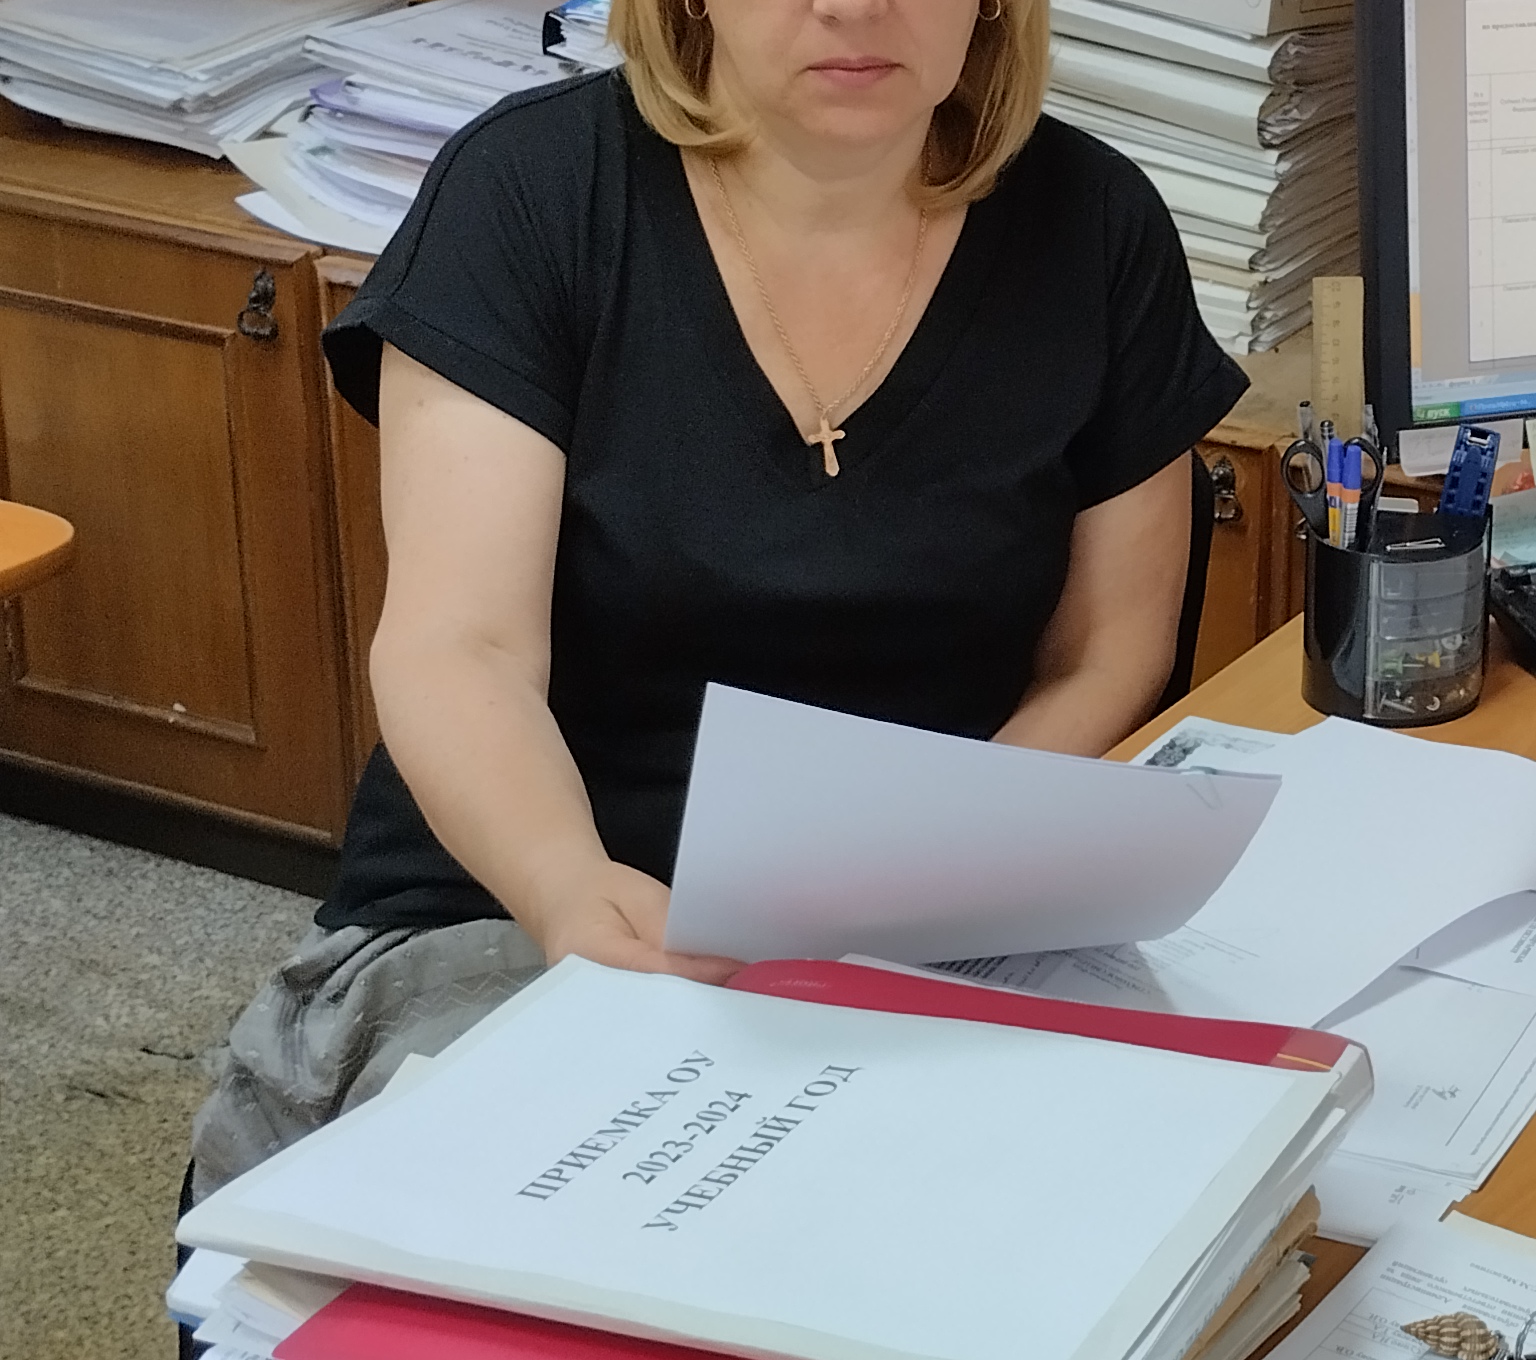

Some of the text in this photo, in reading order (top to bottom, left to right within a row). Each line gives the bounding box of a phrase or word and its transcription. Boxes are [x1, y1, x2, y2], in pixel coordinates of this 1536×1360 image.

[513, 1049, 716, 1201] ПРИЕМКА ОУ
[621, 1088, 754, 1185] 2023-2024
[640, 1063, 866, 1232] УЧЕБНЫЙ ГОД
